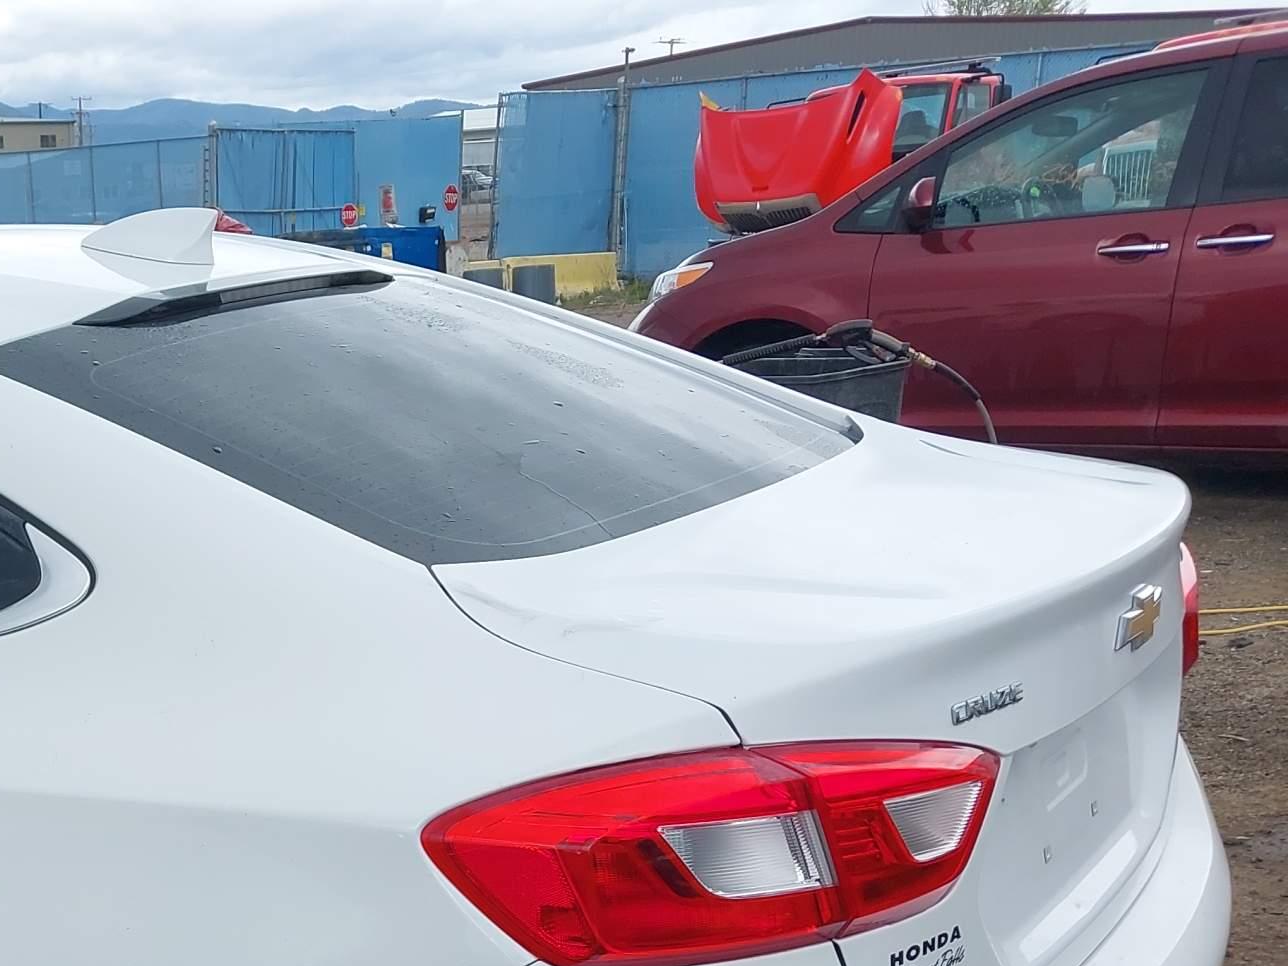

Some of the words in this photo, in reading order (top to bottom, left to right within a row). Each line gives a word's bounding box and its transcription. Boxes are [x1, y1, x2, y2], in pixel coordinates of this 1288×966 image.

[445, 193, 458, 204] STOP
[342, 210, 357, 220] STOP
[950, 680, 1024, 726] CRUZE
